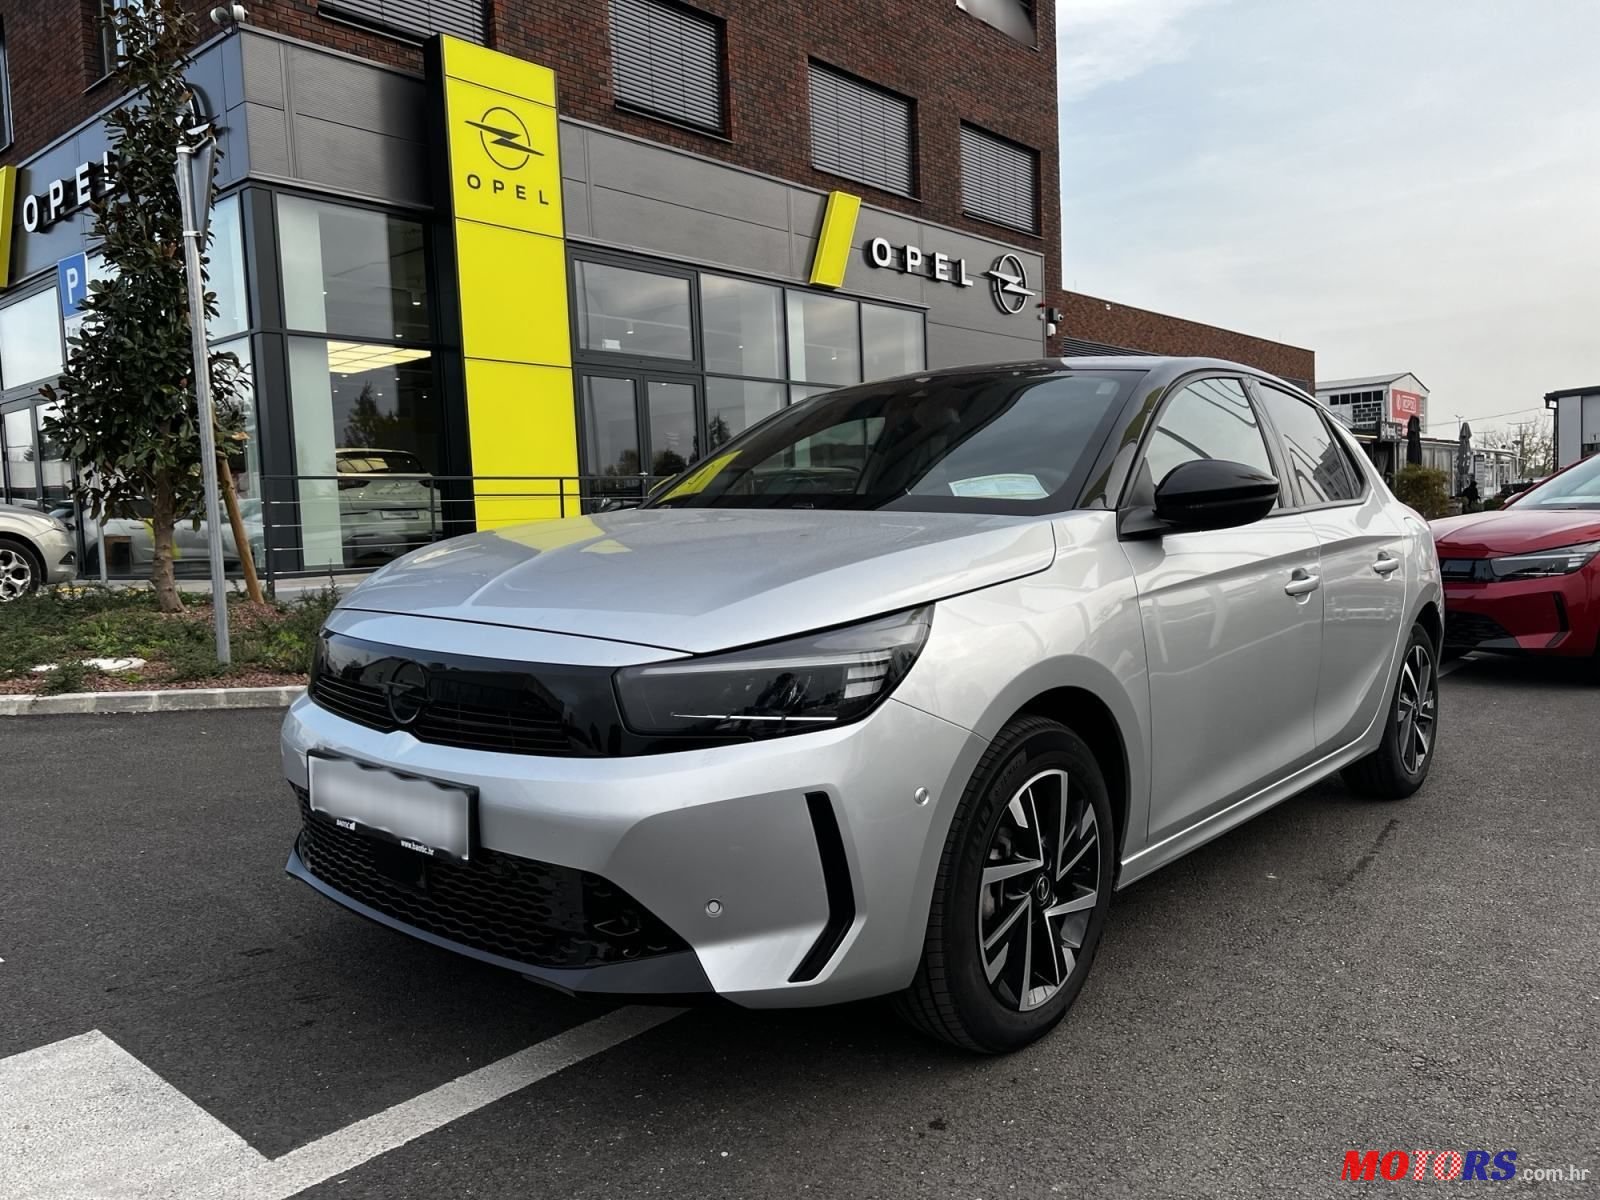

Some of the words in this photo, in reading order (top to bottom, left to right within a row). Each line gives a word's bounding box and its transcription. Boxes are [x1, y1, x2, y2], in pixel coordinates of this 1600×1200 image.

[467, 174, 549, 205] OPEL
[871, 237, 974, 287] OPEL
[66, 267, 79, 305] P
